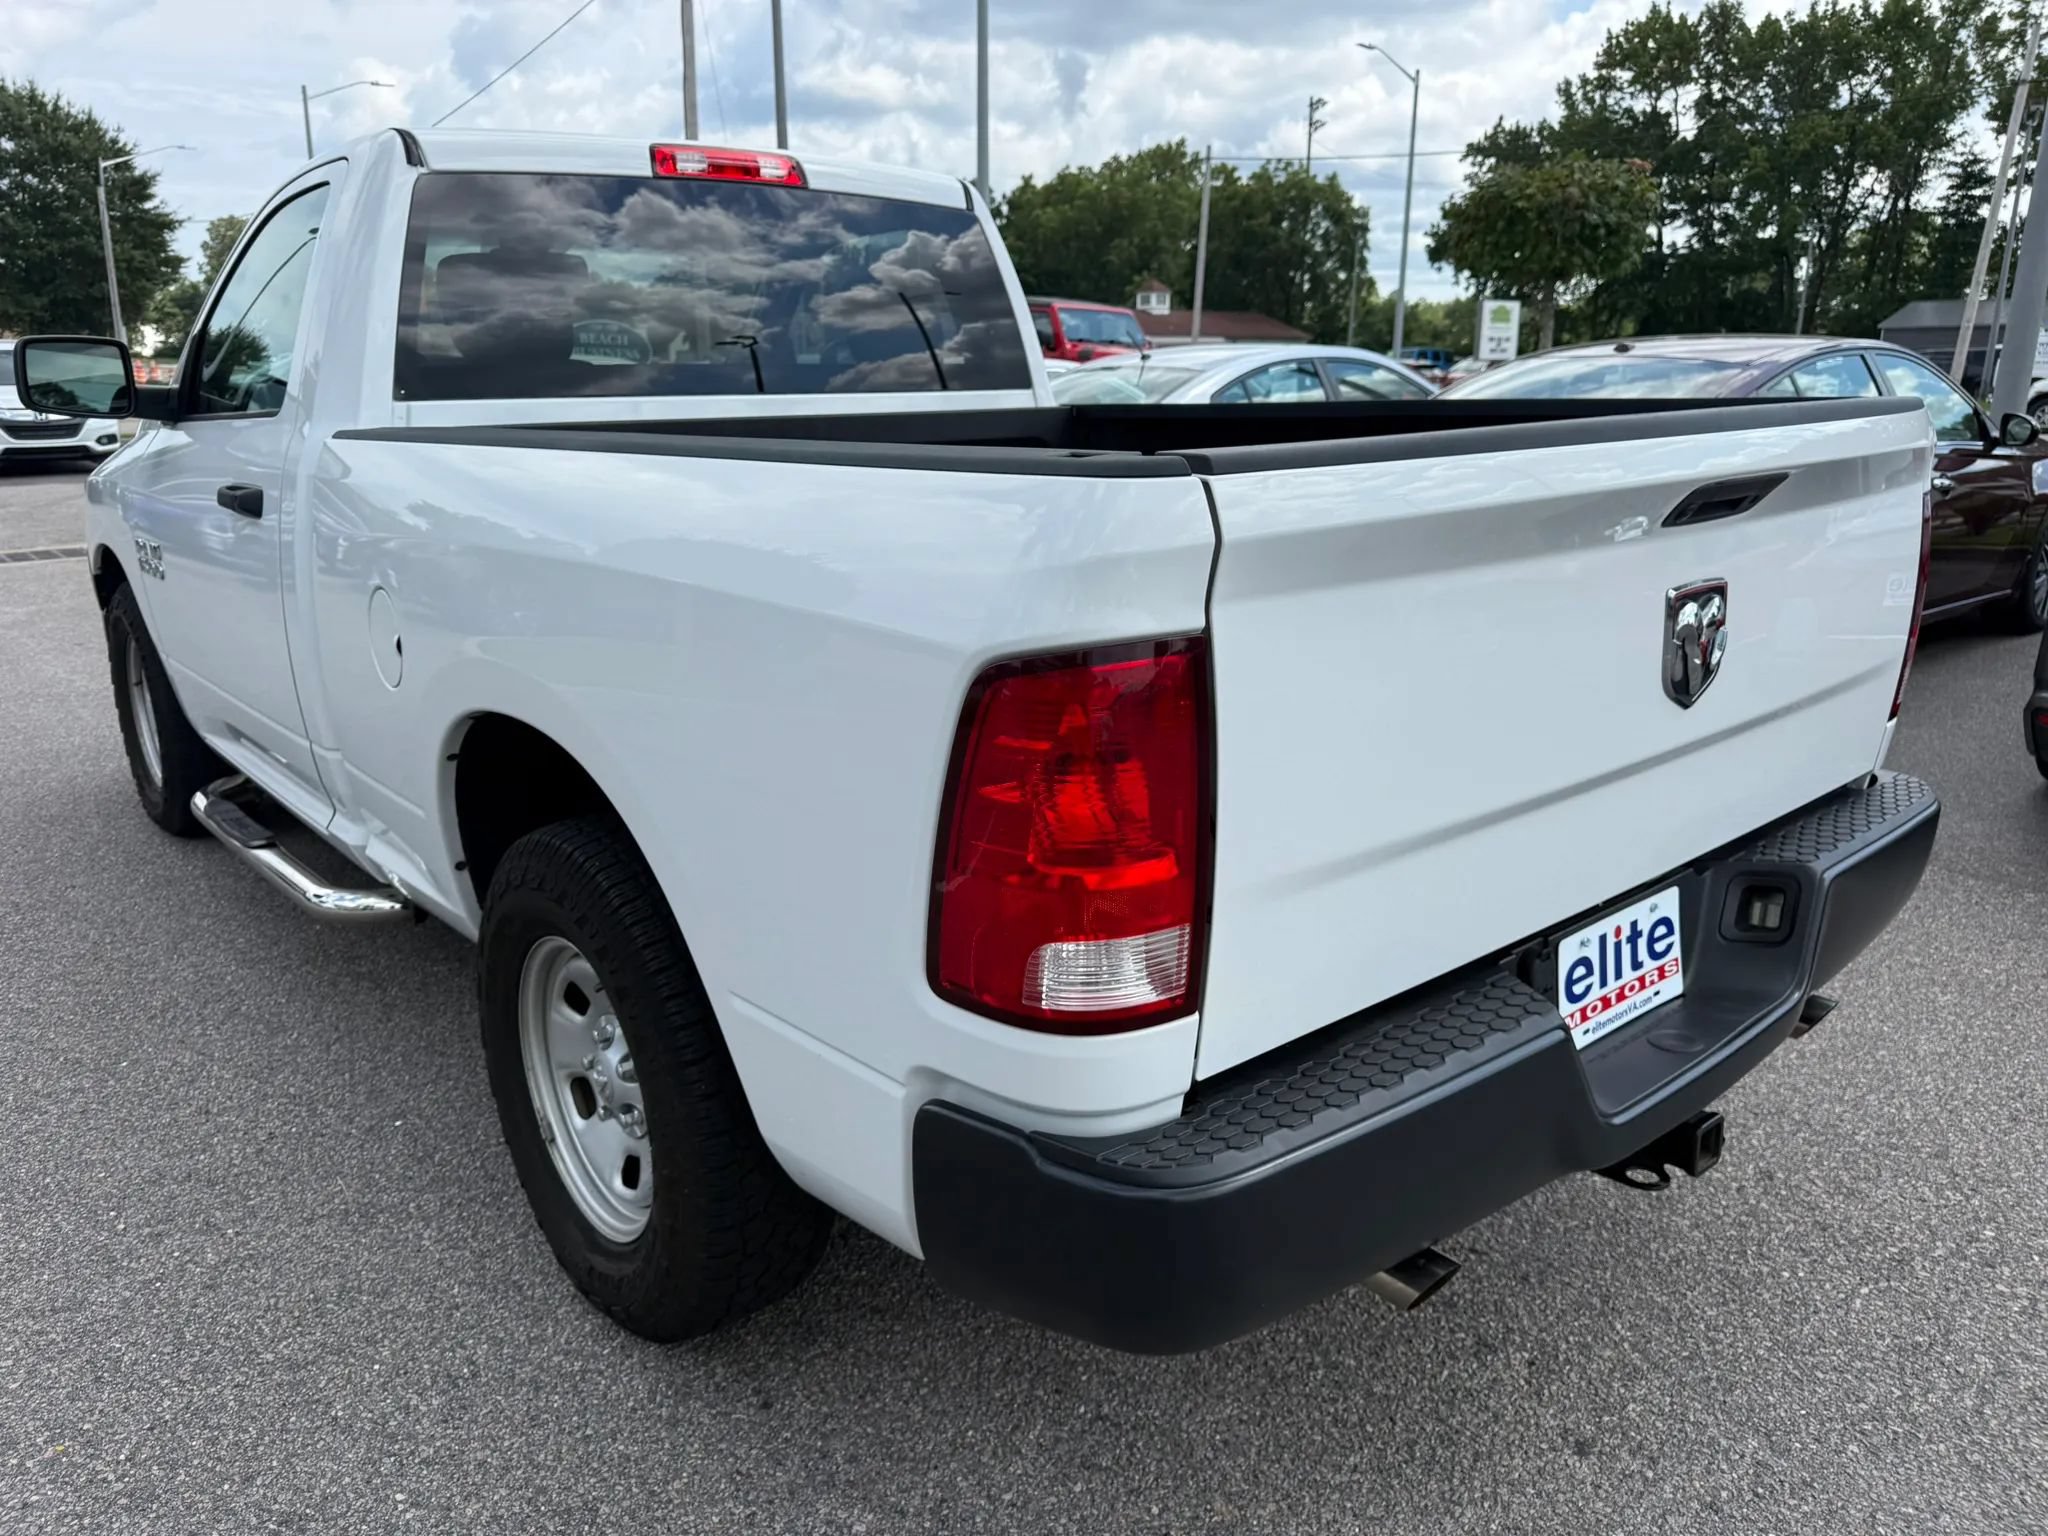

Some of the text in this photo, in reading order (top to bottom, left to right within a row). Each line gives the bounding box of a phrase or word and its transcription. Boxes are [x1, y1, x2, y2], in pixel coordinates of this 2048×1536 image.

[1564, 916, 1675, 1005] elite
[1566, 959, 1679, 1030] MOTORS
[1591, 995, 1653, 1035] elitemotorsVA.com
